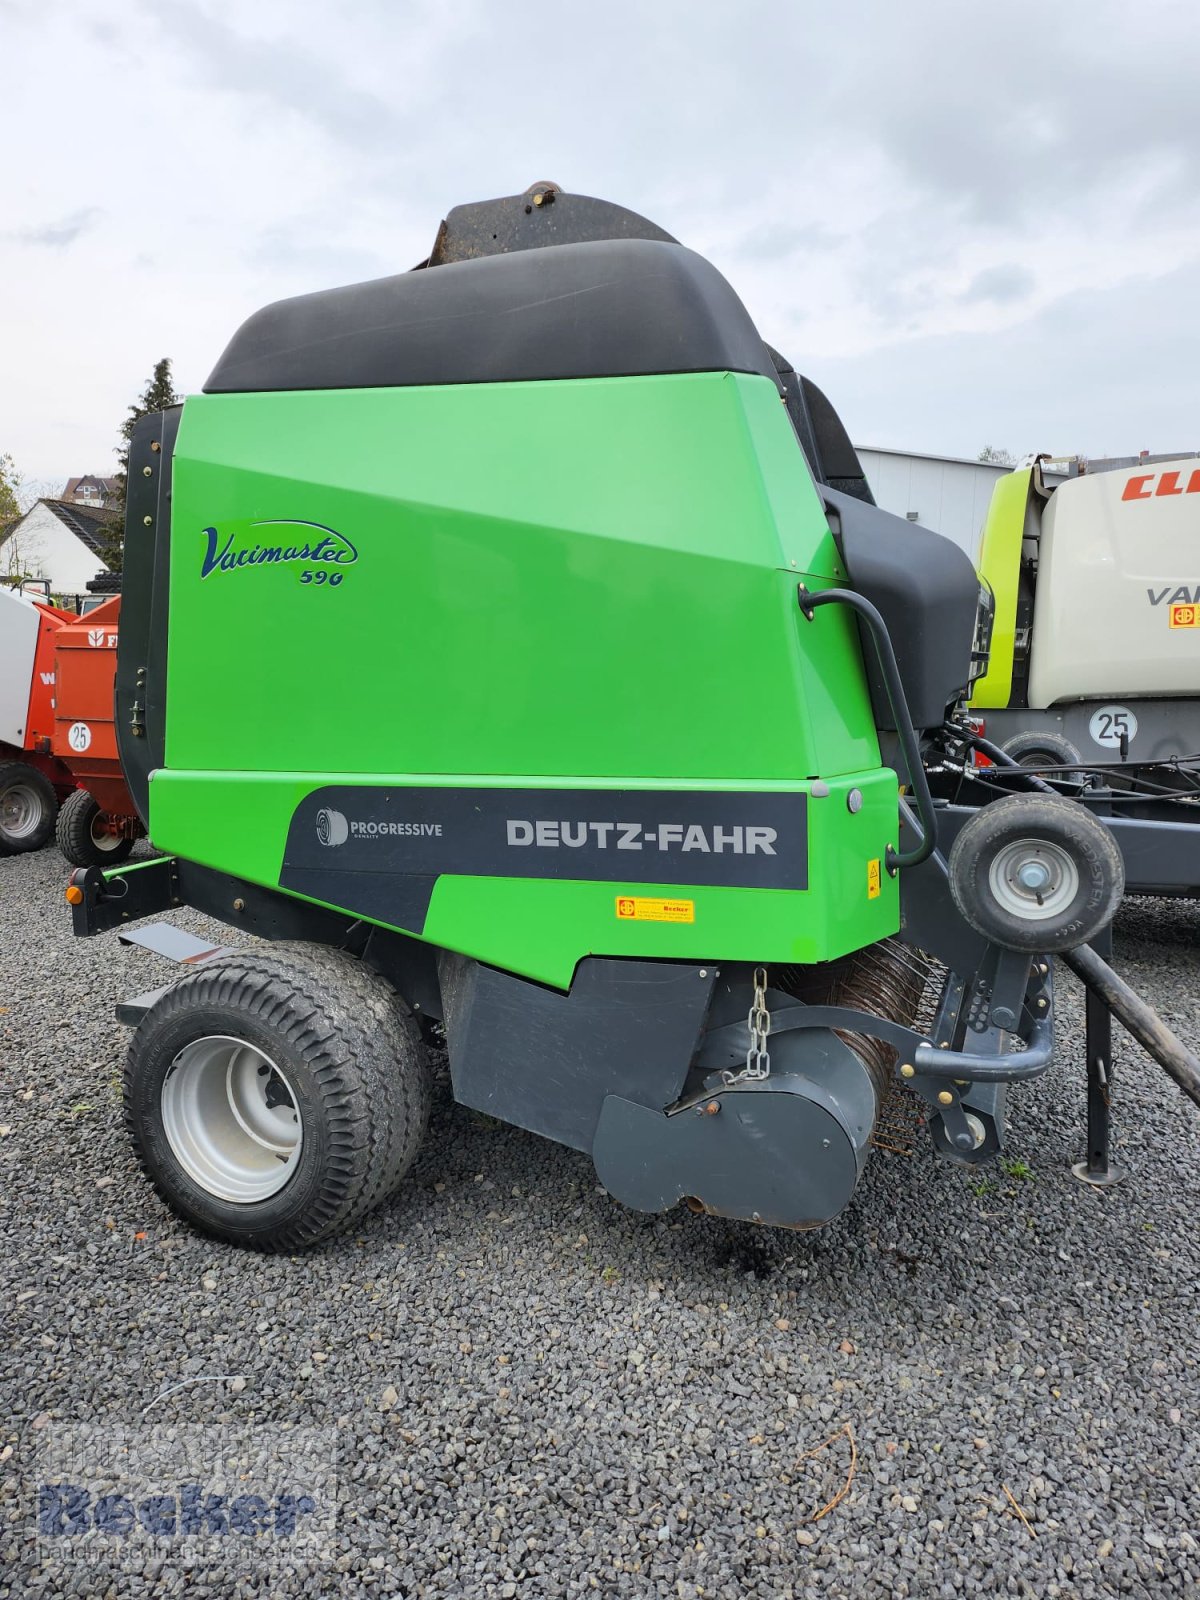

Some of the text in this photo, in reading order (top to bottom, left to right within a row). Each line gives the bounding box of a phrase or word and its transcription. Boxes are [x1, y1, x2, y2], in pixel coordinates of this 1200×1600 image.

[300, 570, 343, 587] 590
[73, 726, 86, 748] 25
[1099, 713, 1128, 739] 25
[350, 821, 443, 837] PROGRESSIVE
[506, 820, 778, 855] DEUTZ-FAHR
